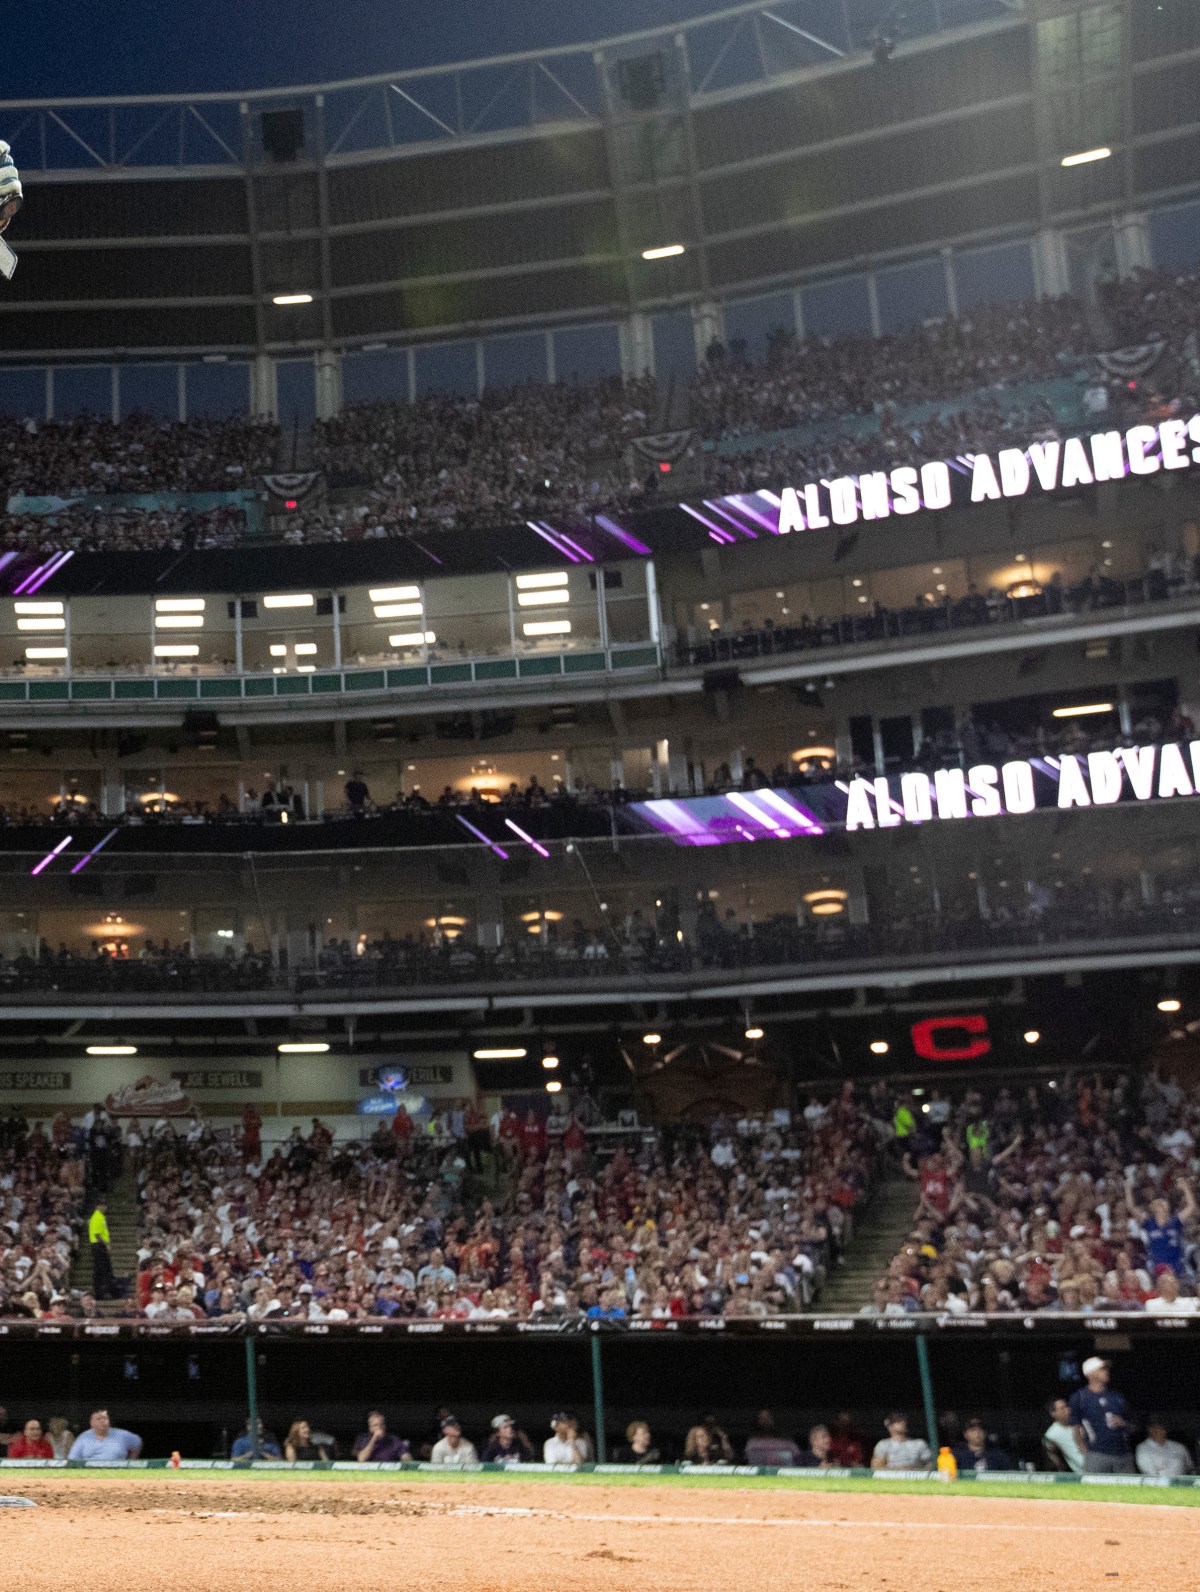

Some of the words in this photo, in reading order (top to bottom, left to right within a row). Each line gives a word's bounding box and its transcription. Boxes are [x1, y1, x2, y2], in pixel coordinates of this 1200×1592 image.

[779, 461, 951, 534] ALONSO
[846, 760, 1035, 831] ALONSO
[911, 1015, 991, 1060] C
[15, 1072, 64, 1088] SPEAKER
